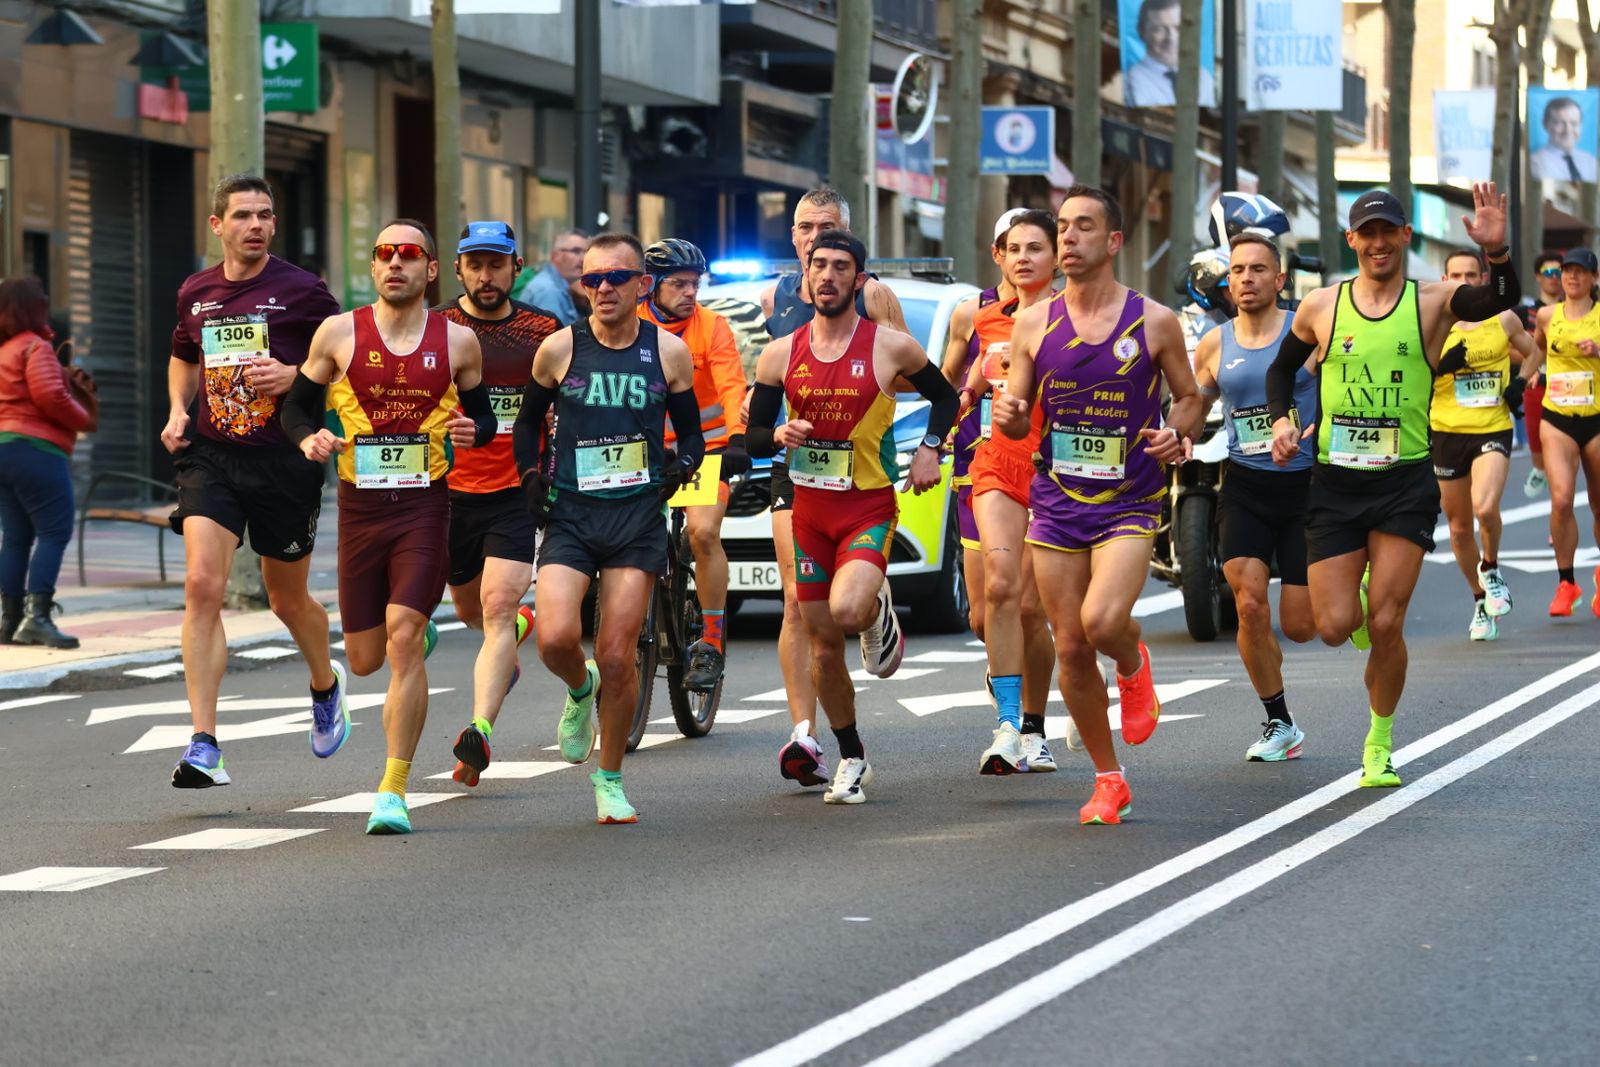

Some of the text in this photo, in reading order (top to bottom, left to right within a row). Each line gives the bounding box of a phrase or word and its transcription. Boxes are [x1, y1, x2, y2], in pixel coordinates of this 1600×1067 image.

[1254, 34, 1334, 68] CERTEZAS
[214, 326, 255, 342] 1306
[1340, 362, 1375, 384] LA
[386, 389, 432, 397] CAJA RURAL
[584, 371, 649, 411] AVS
[813, 388, 860, 396] CAJA RURAL
[1464, 380, 1496, 392] 1009
[1093, 391, 1125, 402] PRIM
[1340, 386, 1409, 408] ANTI-
[385, 401, 417, 411] VINO
[490, 397, 522, 411] 784
[812, 401, 842, 411] VINO
[391, 410, 424, 420] TORO
[820, 411, 853, 422] TORO
[1084, 405, 1129, 419] Macotera
[1347, 429, 1381, 443] 744
[1071, 436, 1106, 453] 109
[380, 447, 405, 462] 87
[601, 447, 625, 463] 17
[808, 450, 830, 465] 94
[739, 567, 777, 585] LRC
